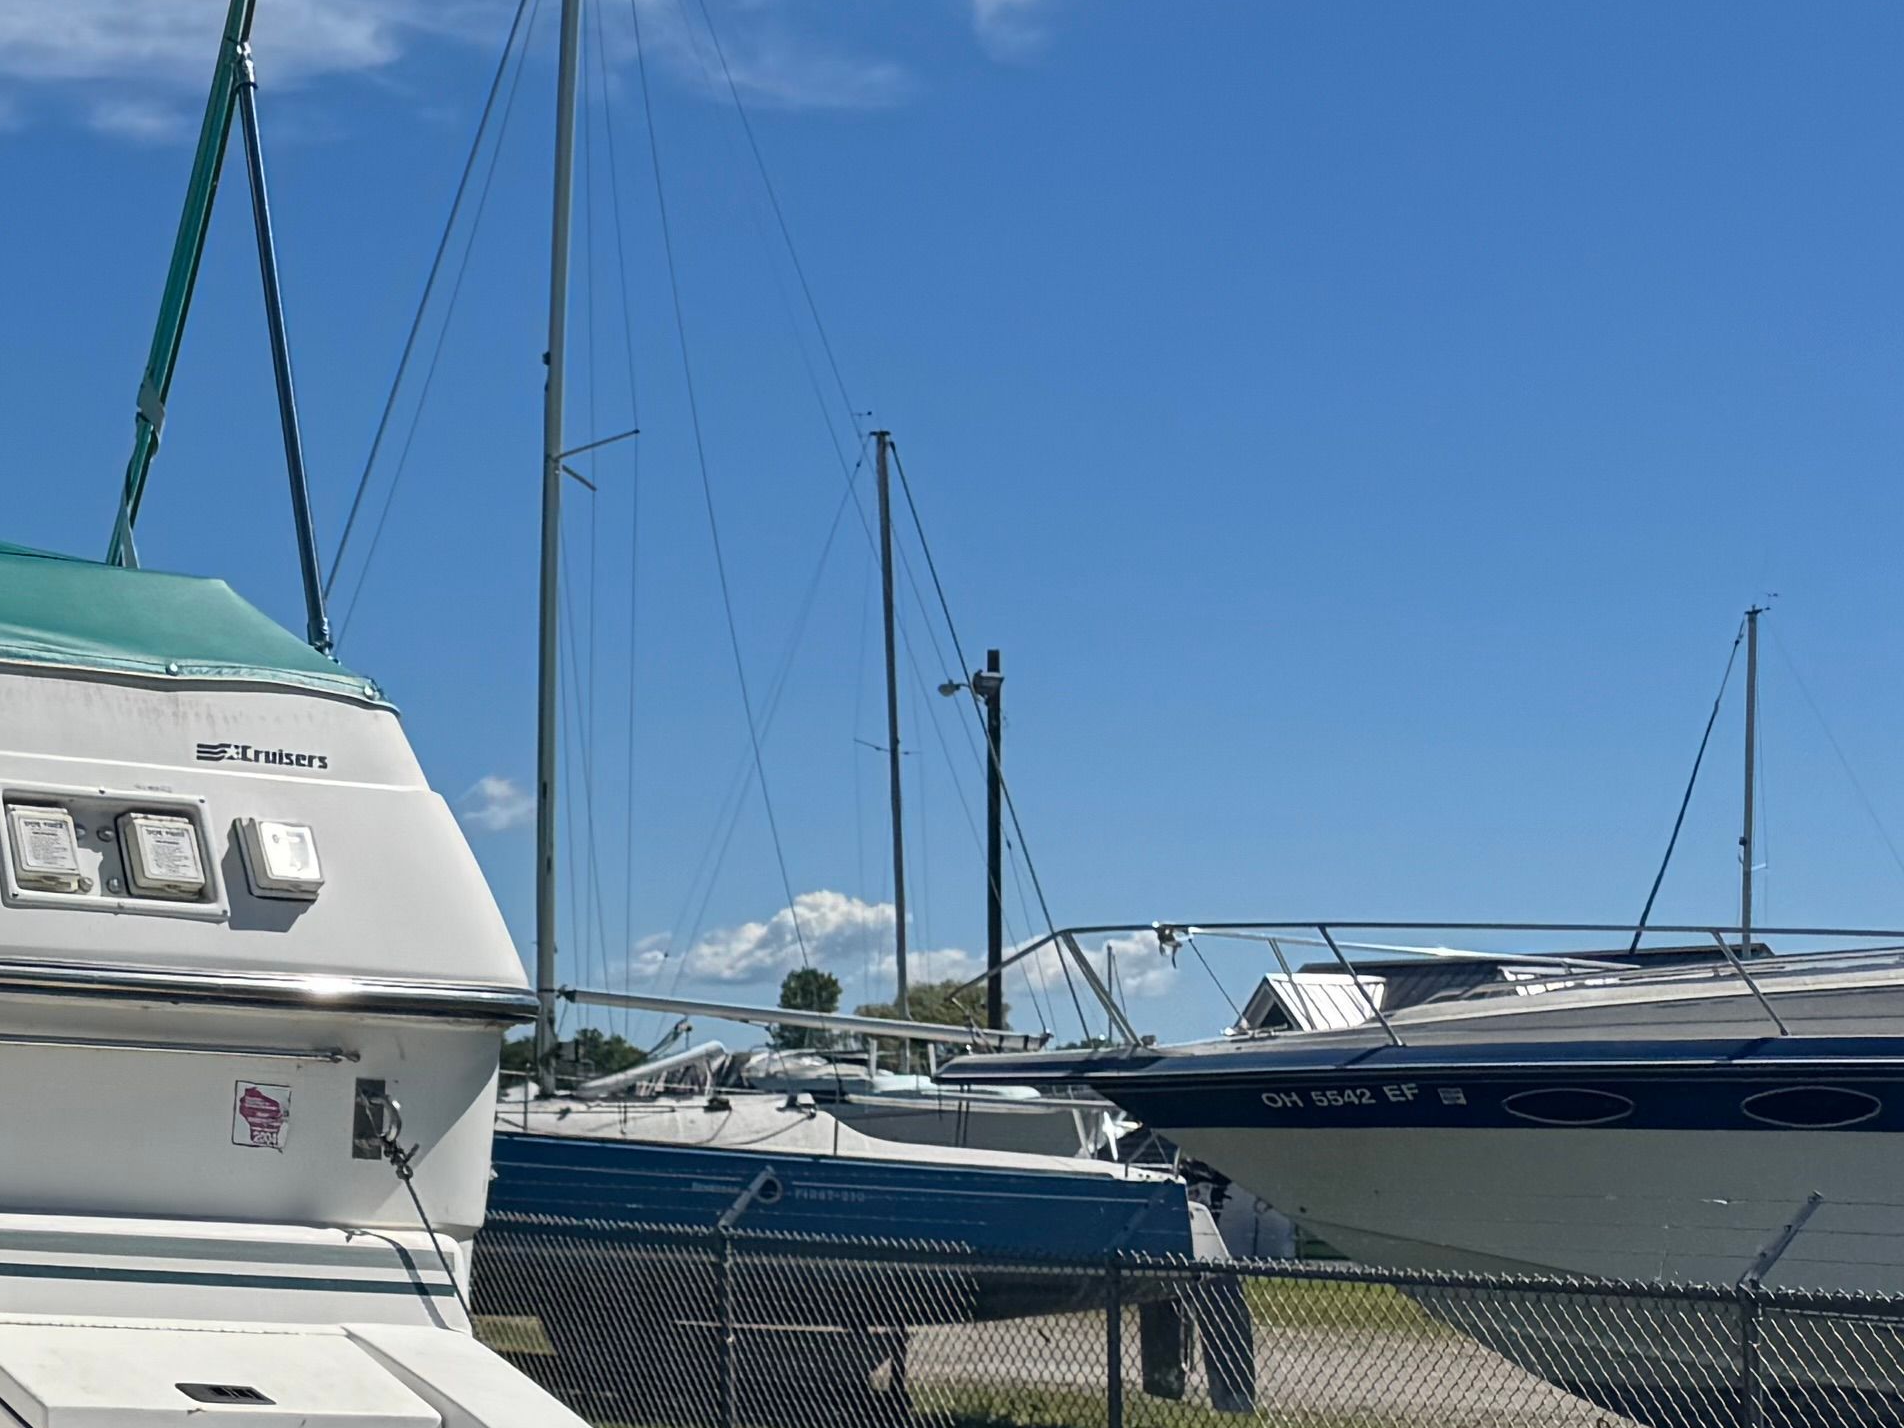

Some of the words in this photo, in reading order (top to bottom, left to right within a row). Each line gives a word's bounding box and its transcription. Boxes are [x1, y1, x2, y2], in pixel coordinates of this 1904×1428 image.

[241, 745, 329, 769] Cruisers
[1261, 1091, 1305, 1108] OH
[1310, 1087, 1377, 1107] 5542
[1382, 1083, 1420, 1102] EF
